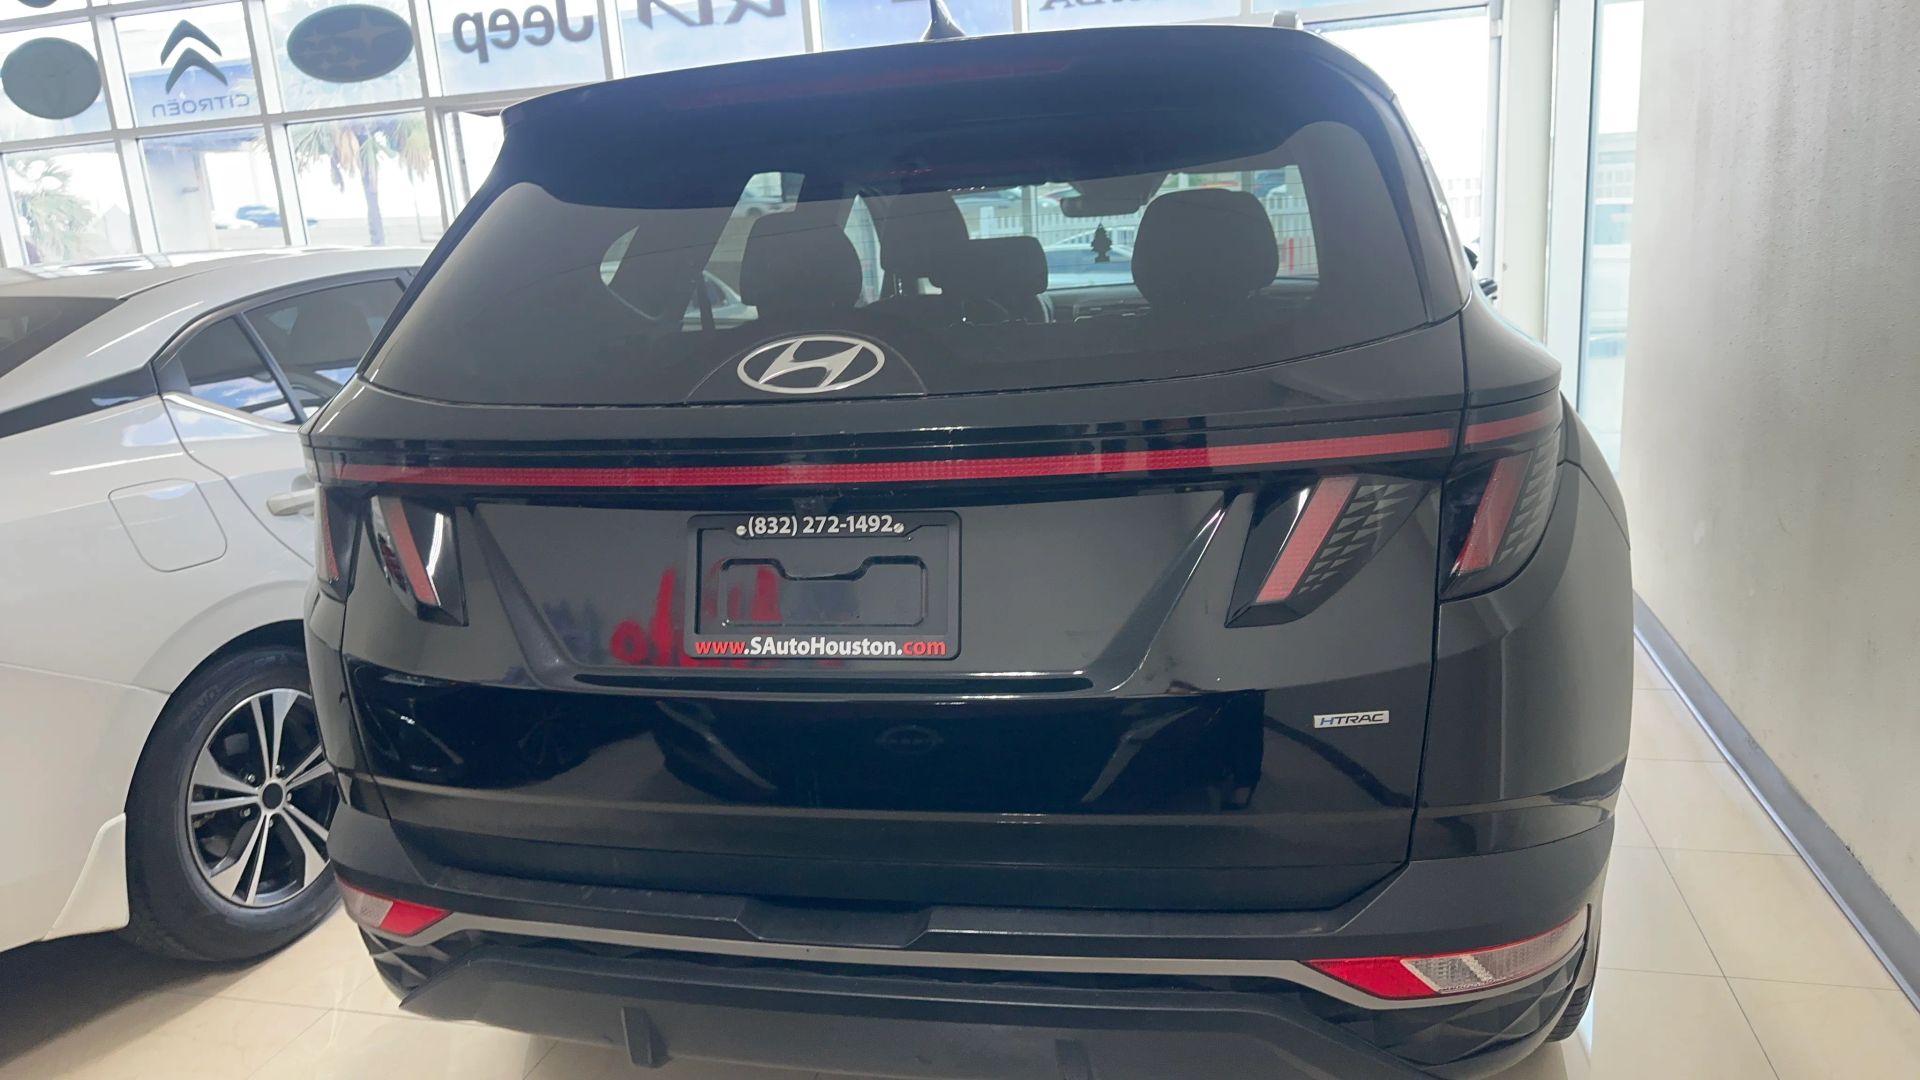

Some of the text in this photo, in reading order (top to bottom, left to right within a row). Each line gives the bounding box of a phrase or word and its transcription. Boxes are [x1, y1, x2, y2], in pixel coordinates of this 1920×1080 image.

[748, 514, 894, 537] (832) 272-1492
[695, 636, 946, 656] www.SAutoHouston.com
[1319, 713, 1385, 726] HTRAC
